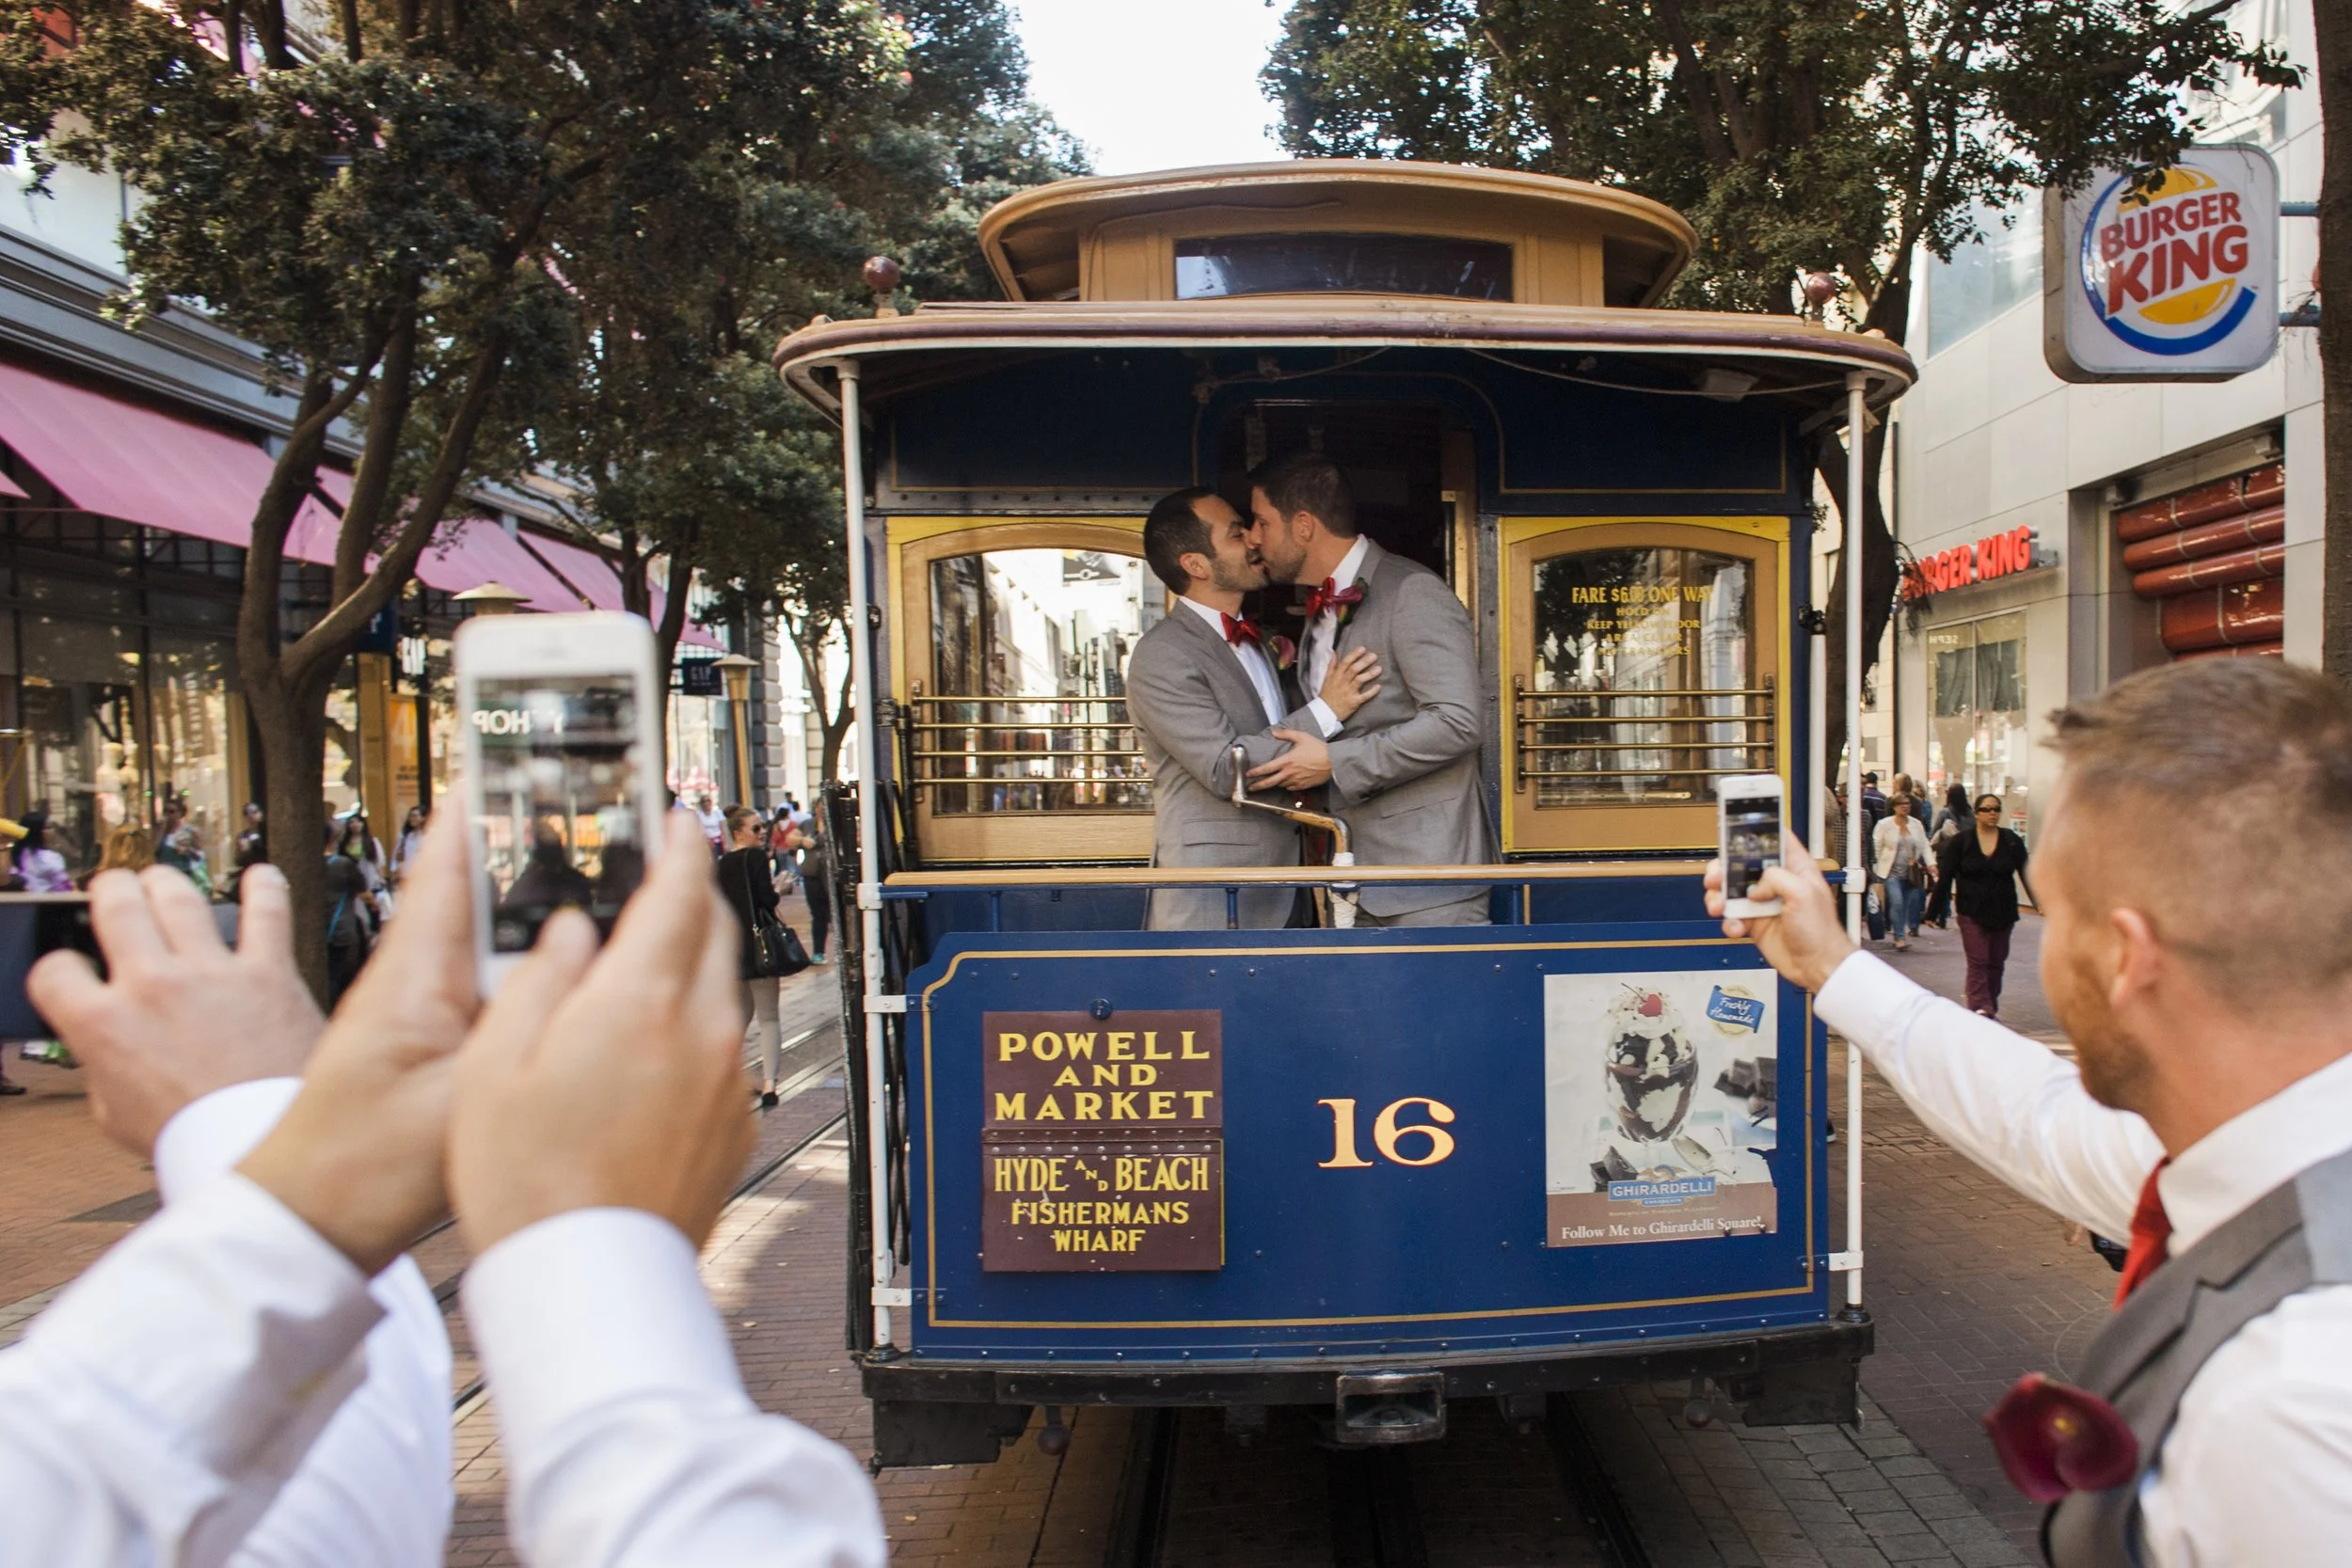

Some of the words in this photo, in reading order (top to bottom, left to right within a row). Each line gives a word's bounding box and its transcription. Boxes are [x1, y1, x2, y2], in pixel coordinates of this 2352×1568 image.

[2100, 192, 2242, 262] BURGER
[2106, 224, 2249, 315] KING
[1977, 524, 2031, 581] KING
[1572, 587, 1607, 603] FARE
[1648, 587, 1678, 603] ONE
[1616, 607, 1648, 616] HOLD
[1587, 621, 1613, 630] KEEP
[999, 1031, 1210, 1061] POWELL
[1053, 1064, 1157, 1086] AND
[994, 1091, 1214, 1120] MARKET
[1316, 1096, 1456, 1168] 16
[993, 1158, 1068, 1192] HYDE
[1074, 1160, 1109, 1192] AND
[1115, 1157, 1209, 1192] BEACH
[1613, 1180, 1713, 1197] GHIRARDELLI
[1011, 1201, 1189, 1225] FISHERMANS
[1053, 1229, 1146, 1252] WHARF
[1562, 1226, 1605, 1239] Follow
[1609, 1225, 1629, 1237] Me
[1632, 1226, 1646, 1235] to
[1648, 1218, 1714, 1234] Ghirardelli
